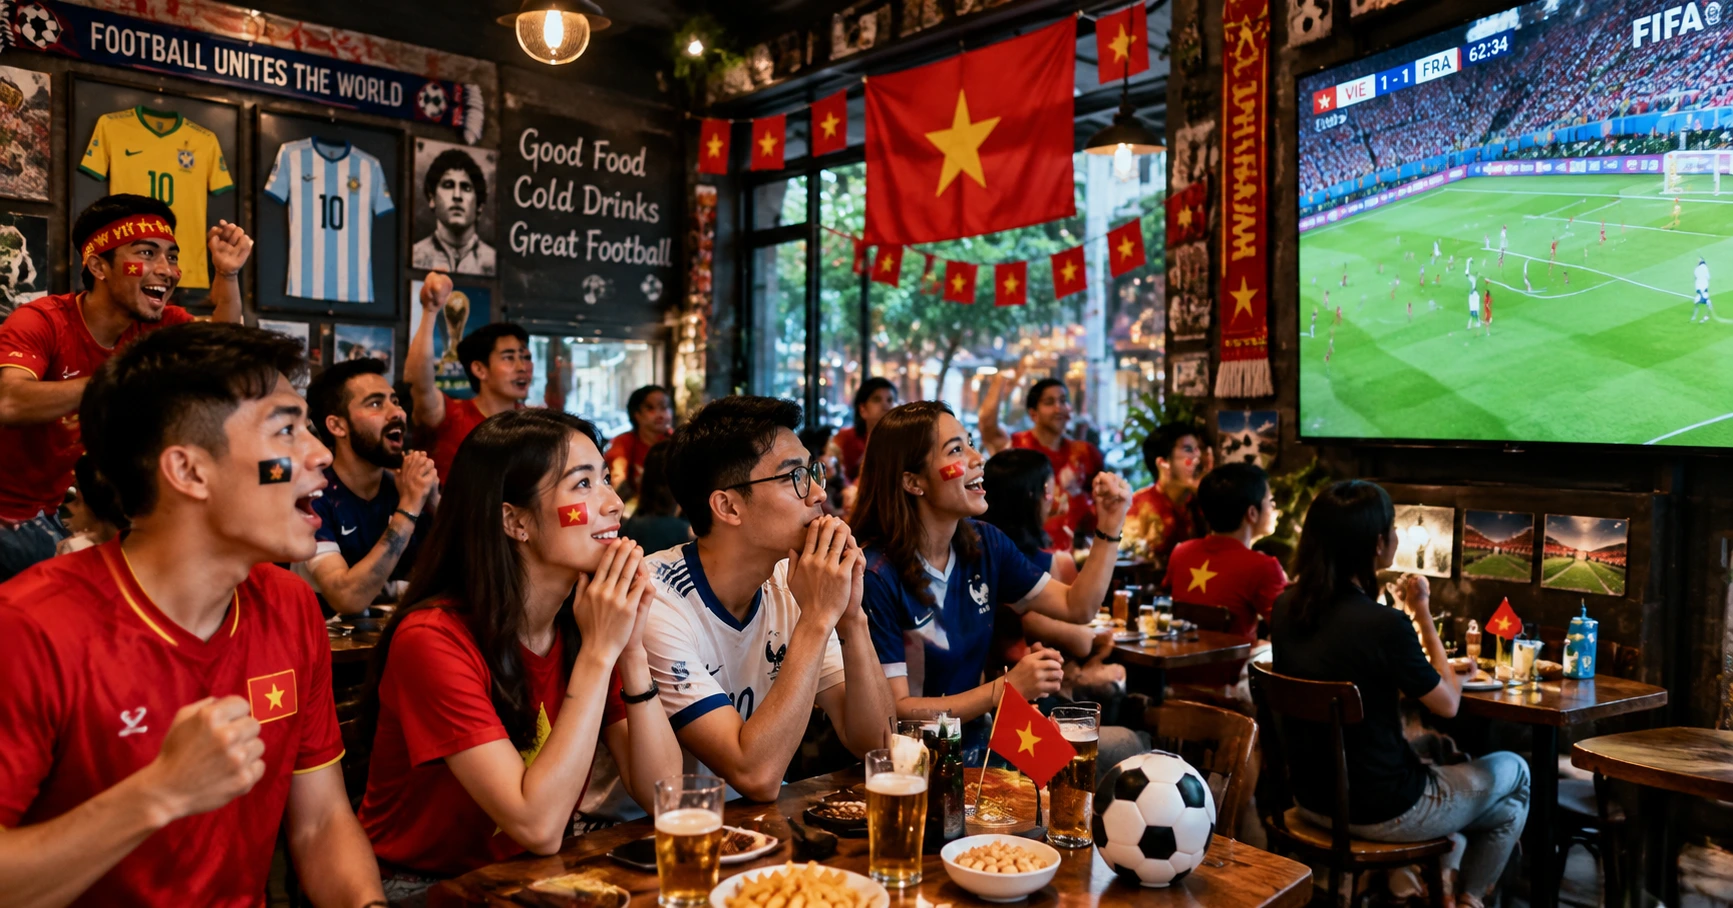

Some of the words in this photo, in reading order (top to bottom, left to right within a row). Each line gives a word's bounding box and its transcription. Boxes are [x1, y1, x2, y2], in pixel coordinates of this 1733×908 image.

[1632, 1, 1704, 49] FIFA
[90, 21, 207, 71] FOOTBALL
[214, 46, 288, 87] UNITES
[293, 62, 331, 95] THE
[336, 71, 403, 107] WORLD
[1345, 81, 1367, 100] VIE
[1422, 55, 1451, 77] FRA
[1468, 35, 1509, 62] 62:34
[519, 127, 584, 173] Good
[593, 139, 647, 177] Food
[147, 170, 174, 207] 10
[319, 194, 344, 231] 10
[513, 174, 575, 213] Cold
[582, 182, 660, 224] Drinks
[509, 220, 579, 258] Great
[585, 229, 673, 268] Football
